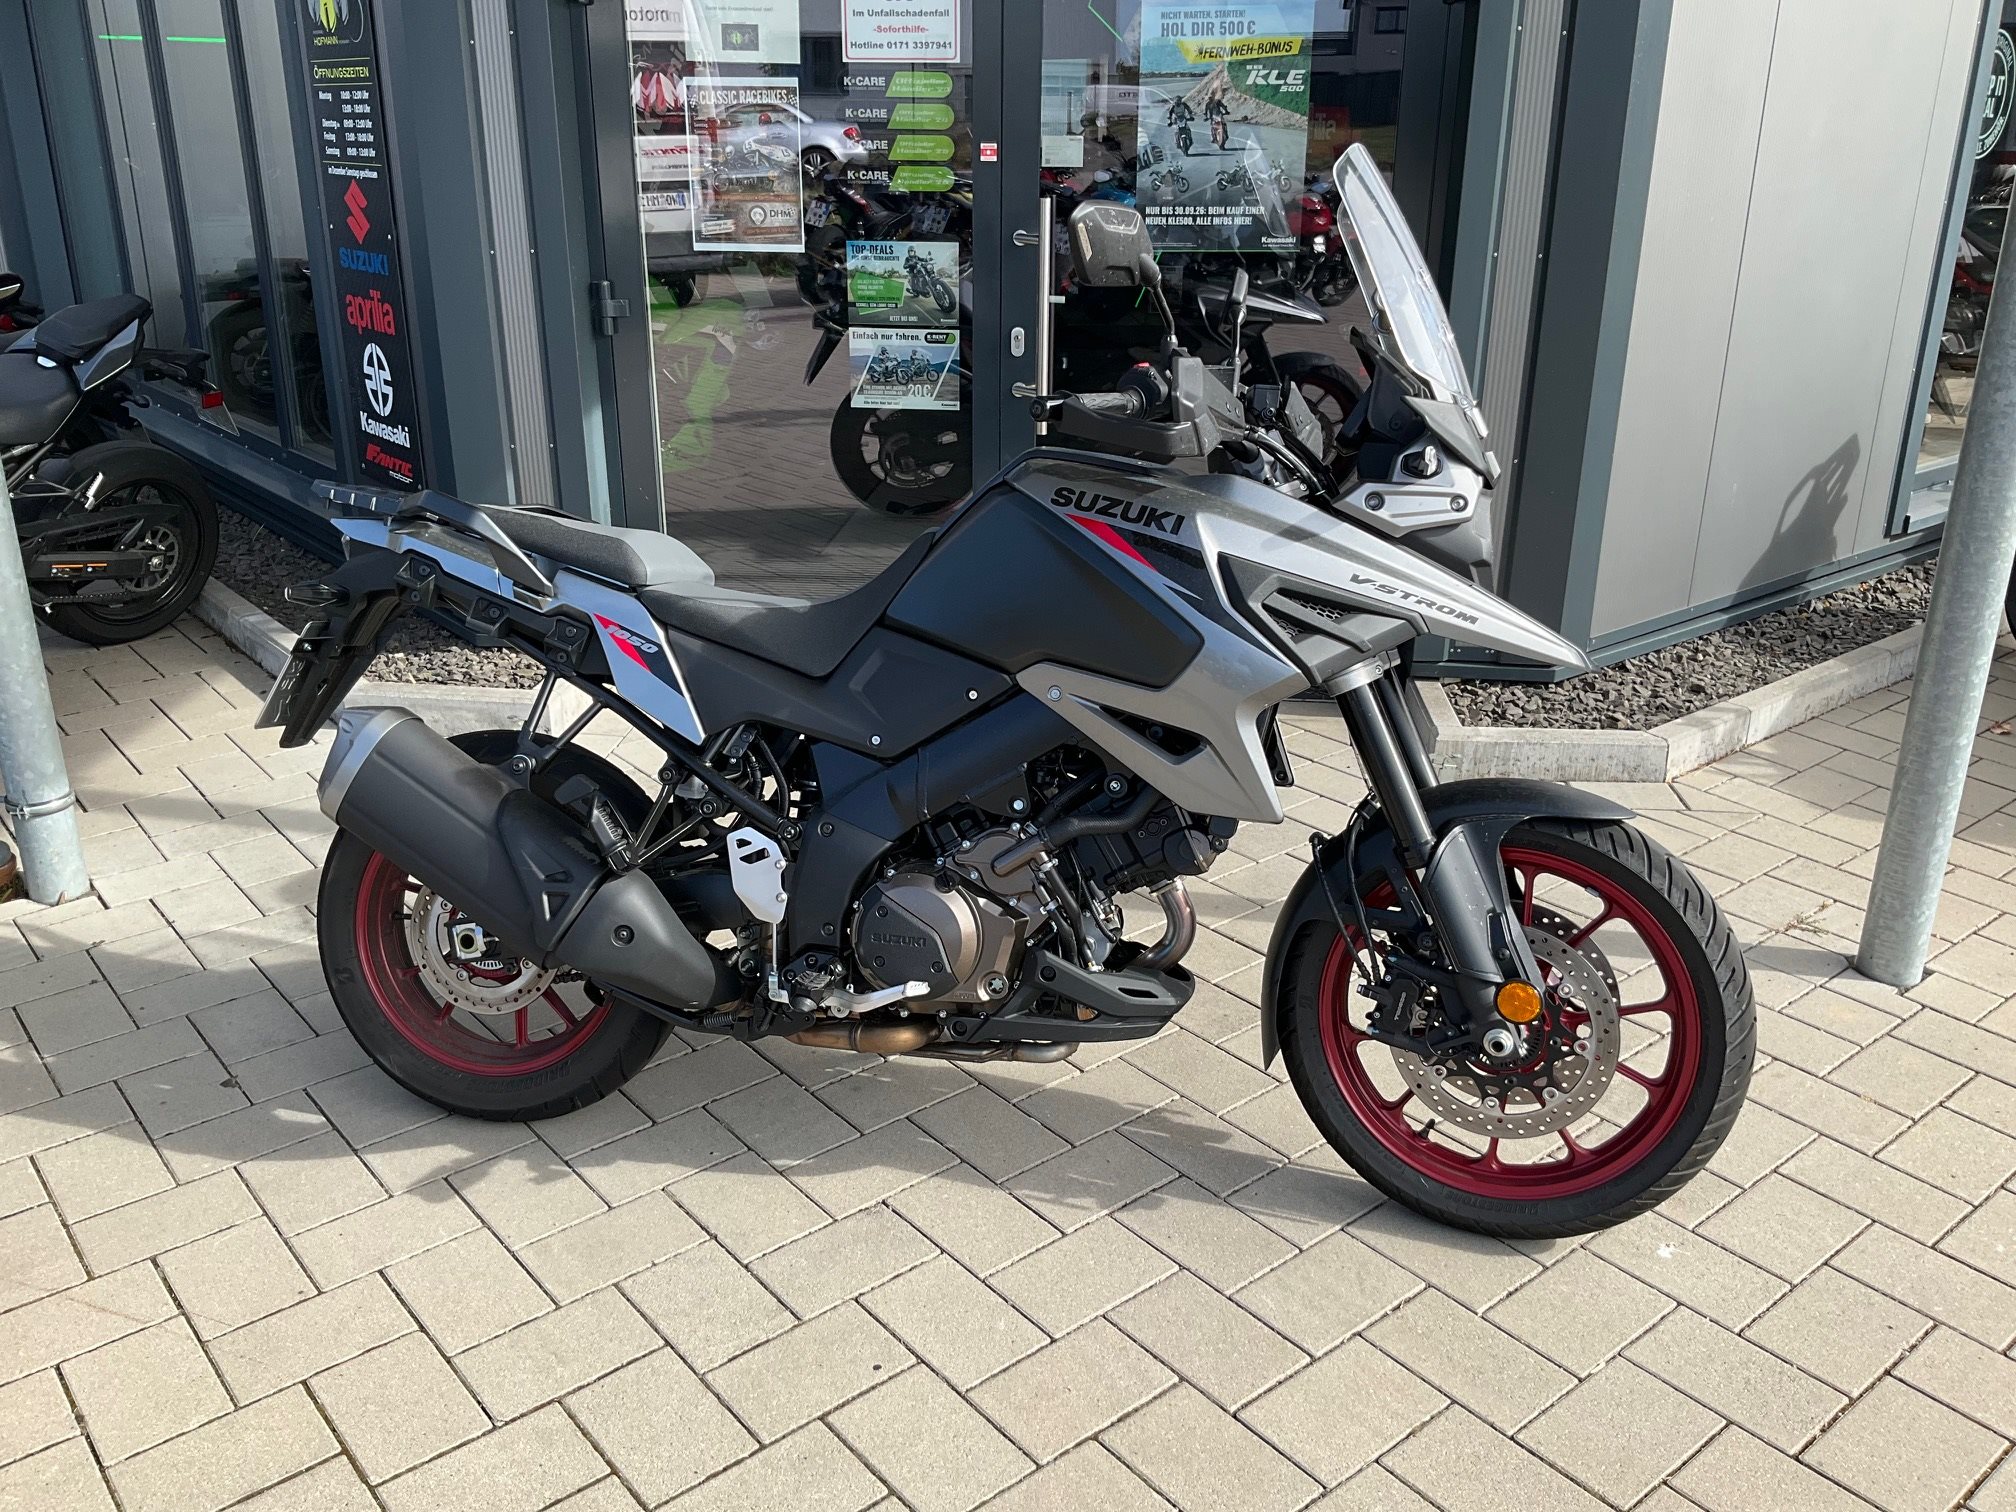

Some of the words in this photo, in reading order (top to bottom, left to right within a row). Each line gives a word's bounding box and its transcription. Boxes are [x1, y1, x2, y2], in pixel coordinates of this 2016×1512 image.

[852, 9, 865, 17] Im
[867, 9, 950, 17] Unfallschadenfall
[1161, 11, 1181, 20] NICHT
[1214, 9, 1246, 19] STARTEN!
[873, 25, 929, 33] -Soforthilfe-
[1161, 23, 1186, 38] HOL
[1191, 22, 1215, 36] DIR
[1219, 21, 1245, 35] 500
[313, 36, 339, 46] HOFMANN
[850, 41, 884, 49] Hotline
[887, 41, 909, 50] 0171
[912, 41, 952, 50] 3397941
[313, 65, 369, 79] ÖFFNUNGSZEITEN
[1246, 70, 1306, 85] KLE
[700, 90, 737, 105] CLASSIC
[739, 90, 787, 105] RACEBIKES
[1146, 206, 1160, 215] NUR
[1162, 206, 1173, 215] BIS
[1208, 206, 1224, 215] BEIM
[1226, 206, 1243, 215] KAUF
[1245, 206, 1265, 215] EINER
[1145, 216, 1167, 225] NEUEN
[1196, 216, 1211, 225] ALLE
[1213, 216, 1232, 225] INFOS
[1234, 216, 1252, 225] HIER!
[1261, 236, 1296, 244] Kawasaki
[851, 244, 894, 255] TOP-DEALS
[339, 247, 389, 276] SUZUKI
[346, 289, 396, 336] aprilia
[852, 331, 878, 340] Einfach
[896, 332, 921, 340] fahren.
[360, 411, 410, 448] Kawasaki
[367, 443, 413, 477] FANTIC
[1050, 486, 1186, 536] SUZUKI
[871, 932, 927, 948] SUZUKI
